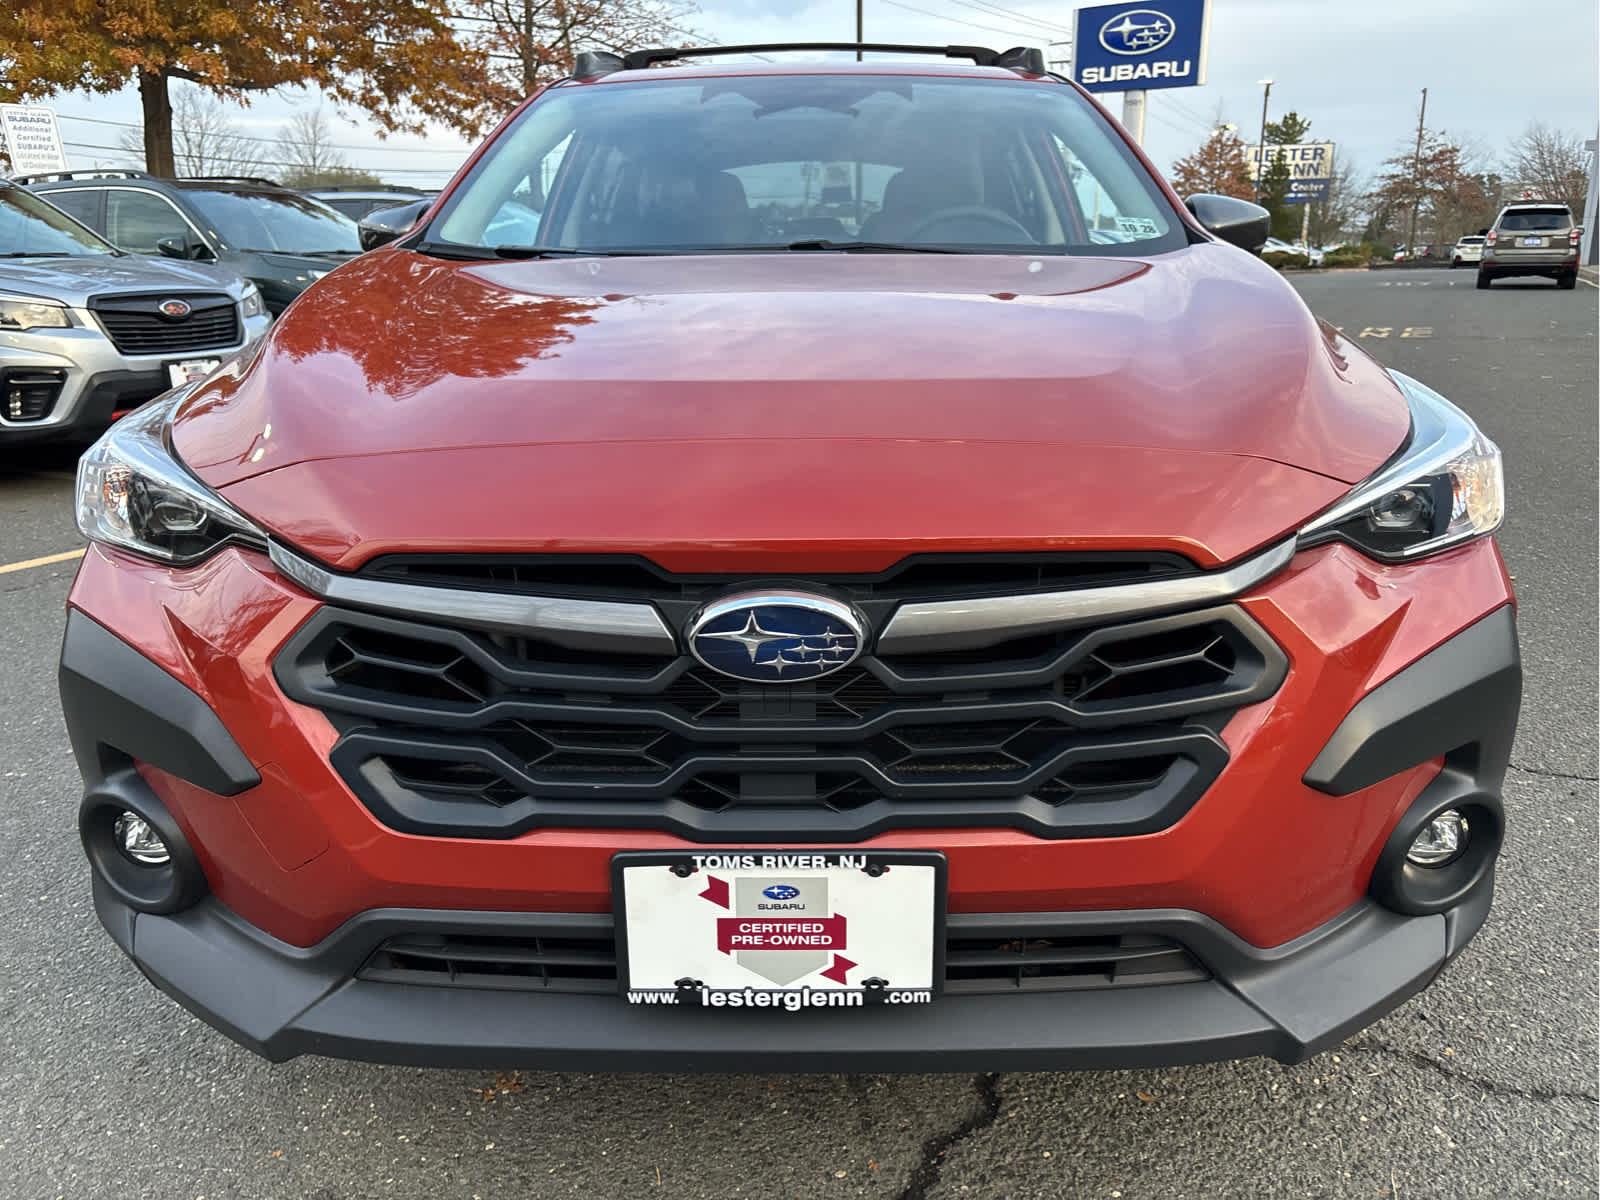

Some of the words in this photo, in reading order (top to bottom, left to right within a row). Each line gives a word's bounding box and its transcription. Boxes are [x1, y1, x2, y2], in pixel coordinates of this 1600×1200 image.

[1081, 60, 1191, 84] SUBARU
[7, 116, 51, 124] SUBARU
[12, 125, 51, 133] Additional
[17, 134, 51, 142] Certified
[17, 143, 55, 151] SUBARU'S
[692, 855, 755, 869] TOMS
[839, 855, 867, 869] NJ
[739, 923, 824, 933] CERTIFIED
[731, 935, 833, 945] PRE-OWNED
[627, 991, 679, 1004] www.
[701, 987, 863, 1011] lesterglenn
[884, 990, 931, 1003] .com
